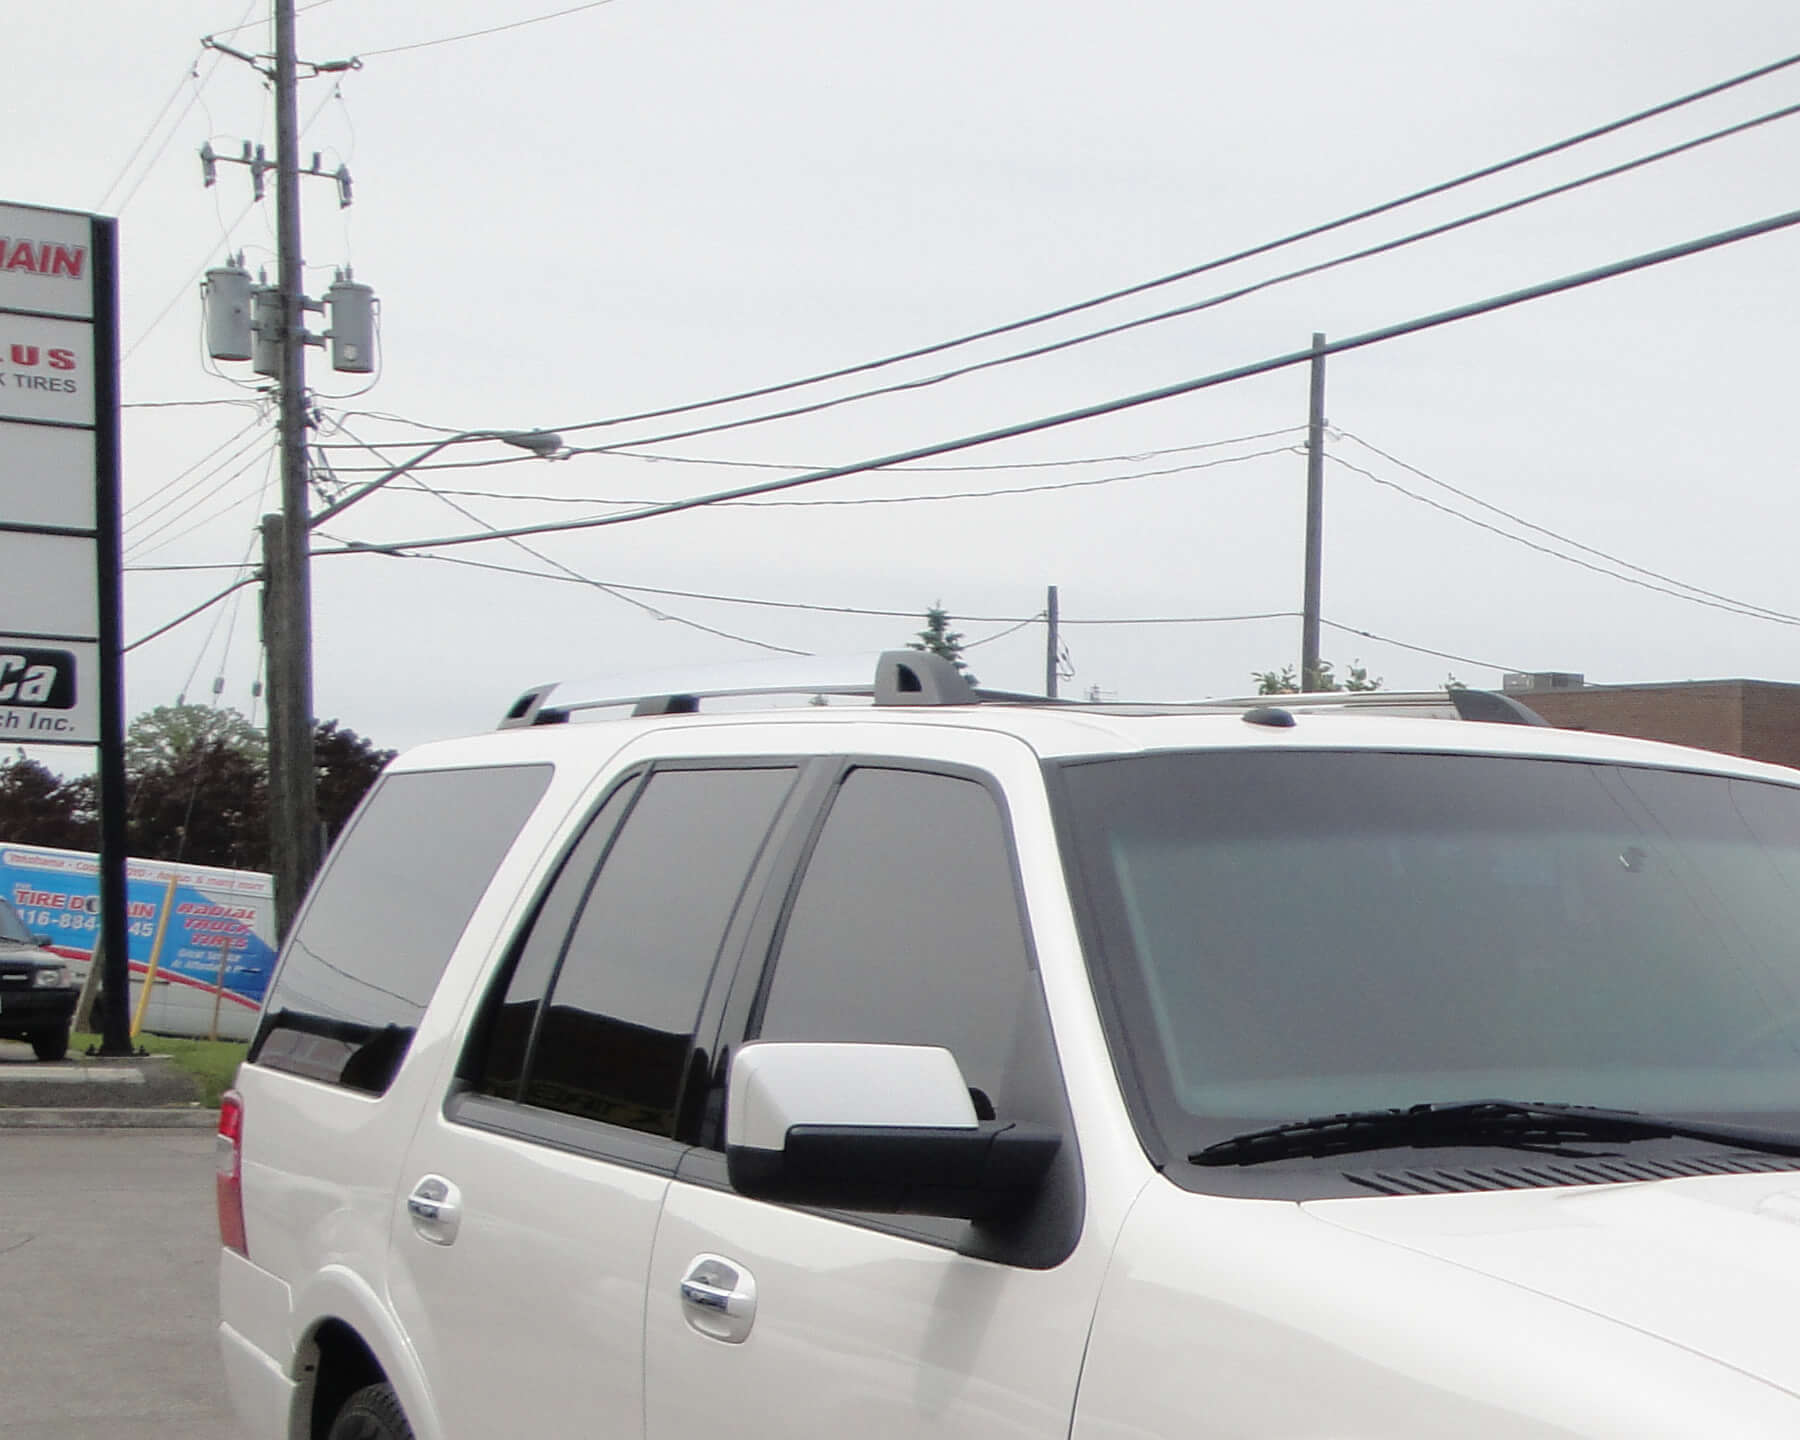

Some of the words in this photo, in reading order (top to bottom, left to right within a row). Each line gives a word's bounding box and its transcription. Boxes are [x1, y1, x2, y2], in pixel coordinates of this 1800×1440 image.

[0, 344, 77, 371] US
[13, 374, 77, 393] TIRES
[30, 711, 75, 731] Inc.
[15, 889, 66, 909] TIRE
